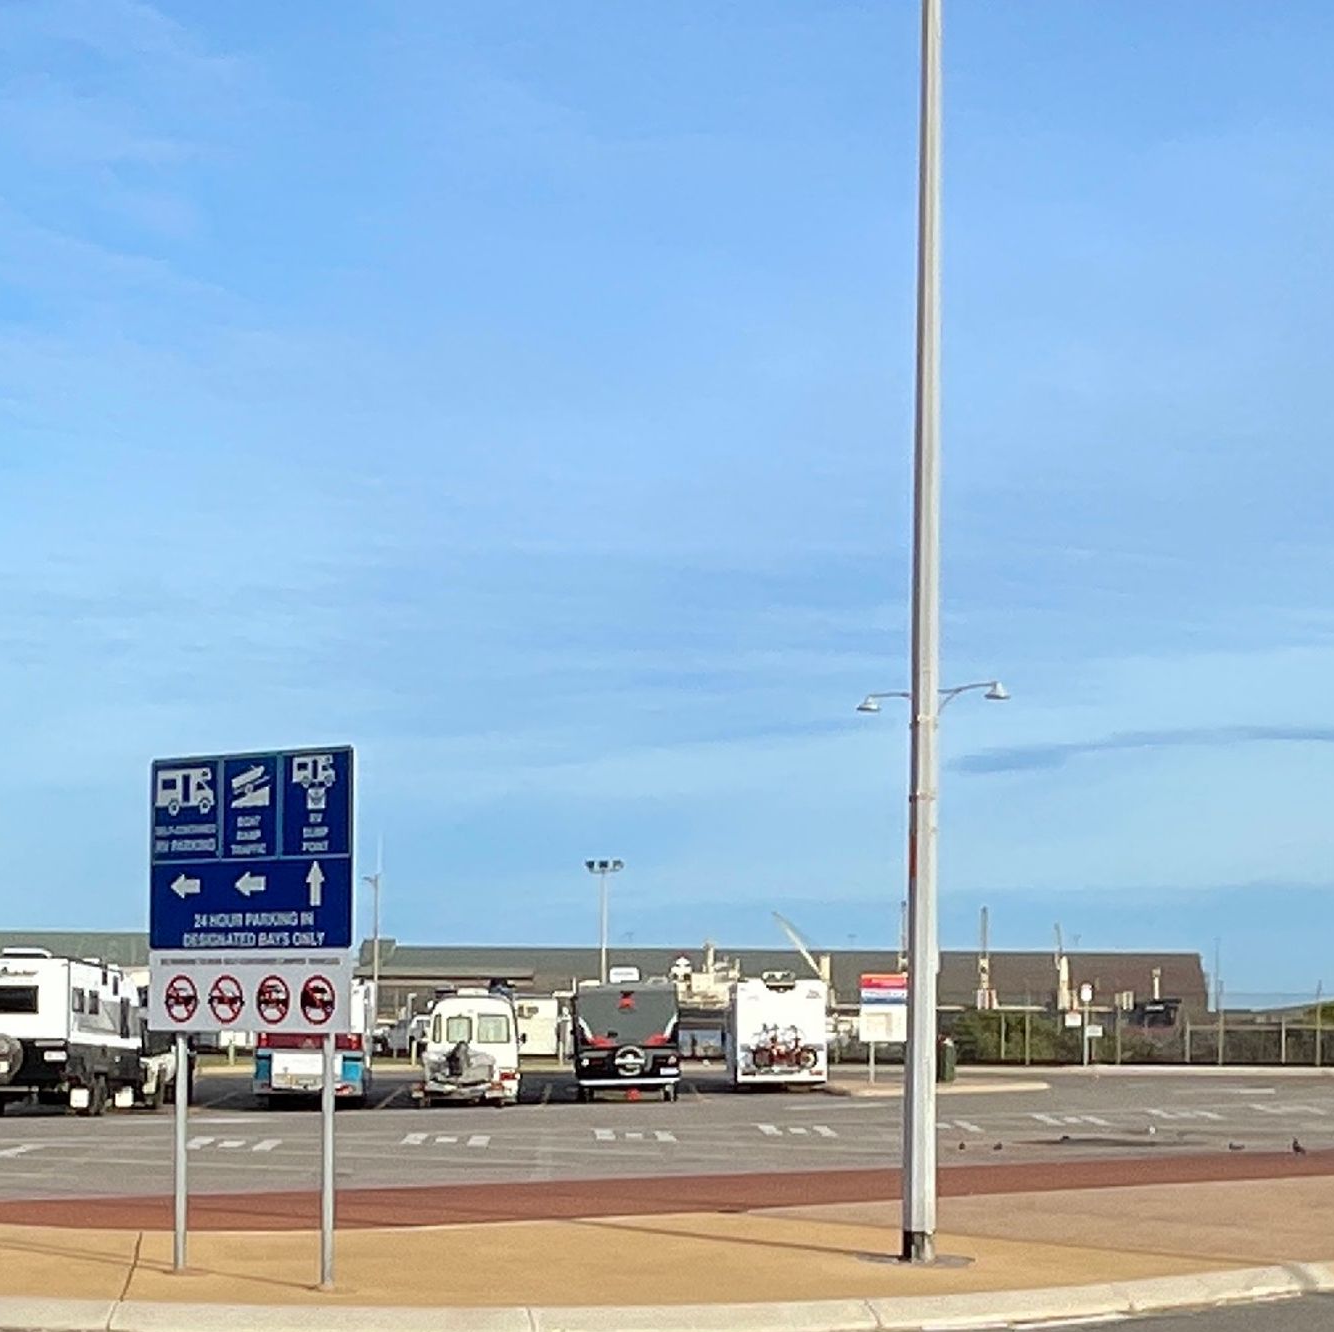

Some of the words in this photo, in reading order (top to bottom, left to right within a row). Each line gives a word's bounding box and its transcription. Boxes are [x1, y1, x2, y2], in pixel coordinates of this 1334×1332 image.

[194, 913, 207, 928] 24
[209, 913, 243, 928] HOUR
[245, 912, 298, 927] PARKING
[300, 911, 315, 926] IN
[183, 932, 256, 947] DESIGNATED
[258, 931, 290, 946] BAYS
[292, 931, 326, 946] ONLY
